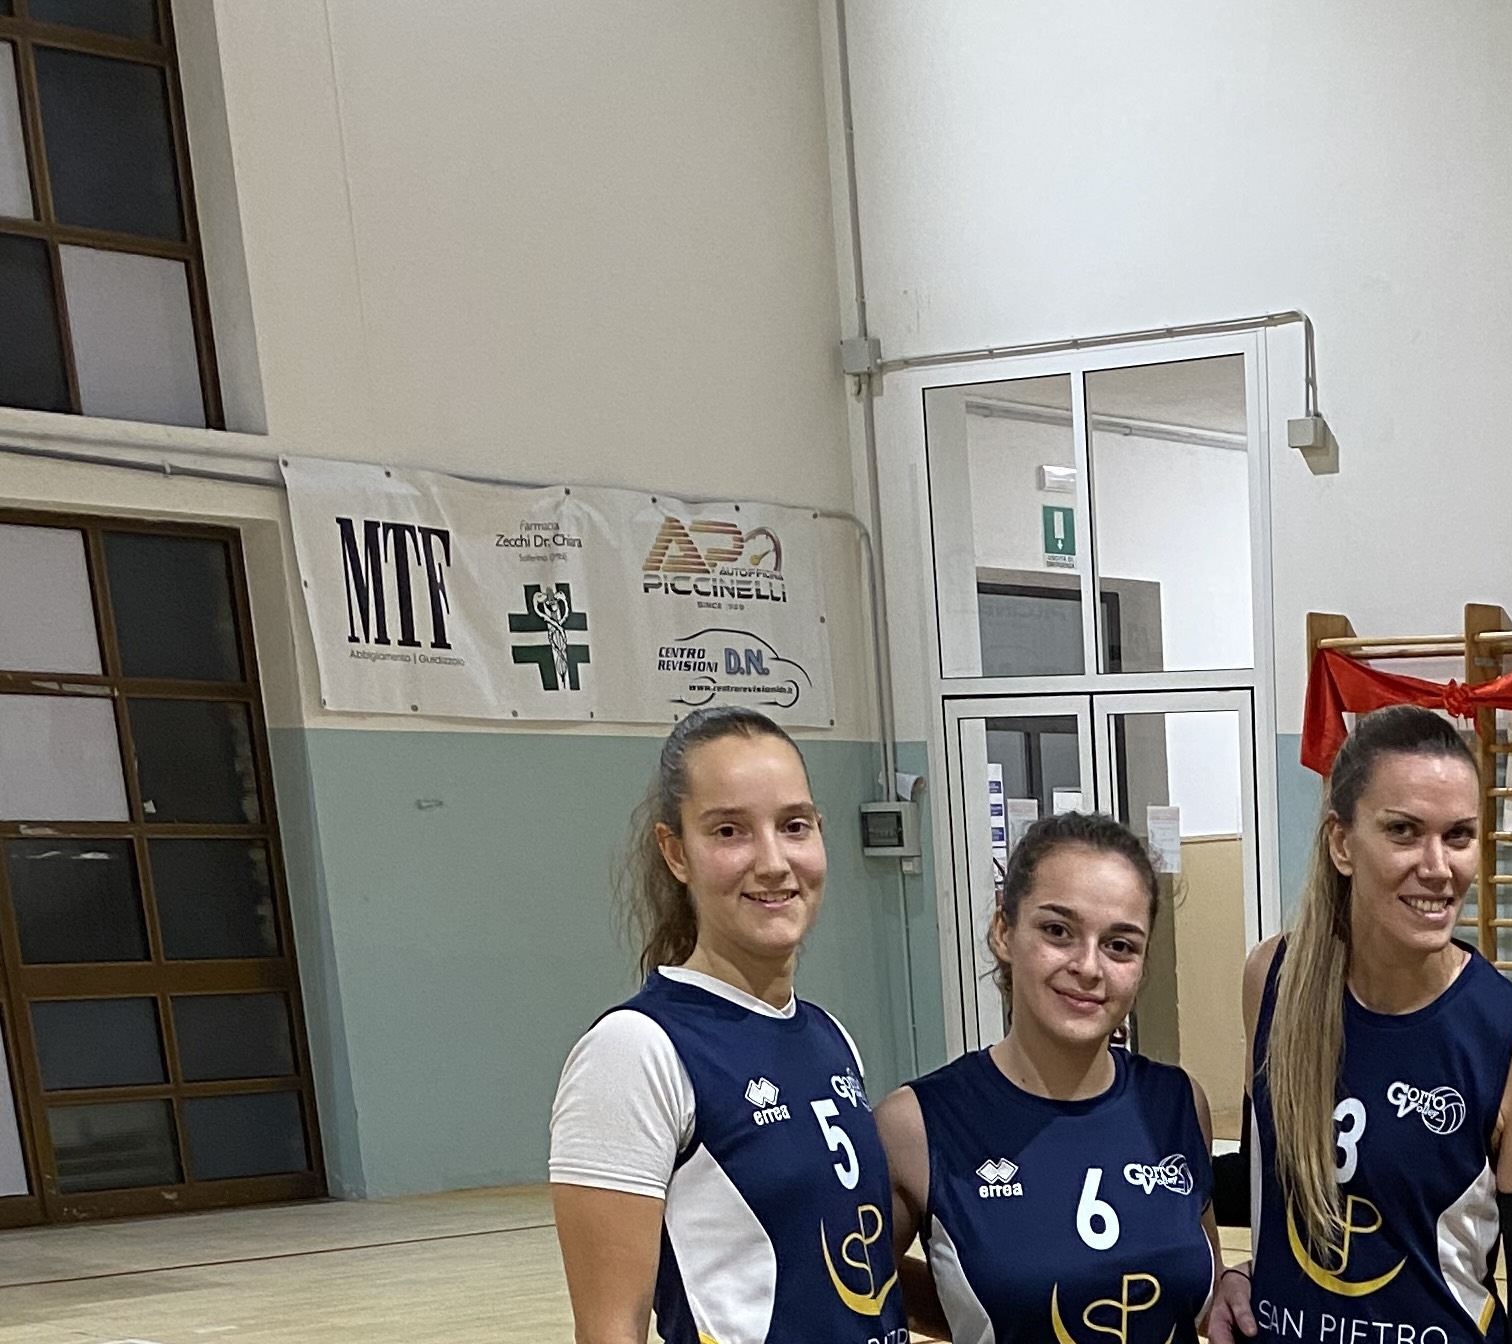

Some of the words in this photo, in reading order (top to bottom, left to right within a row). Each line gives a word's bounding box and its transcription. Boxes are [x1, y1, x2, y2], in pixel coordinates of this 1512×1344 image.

[495, 534, 530, 548] Zecchi
[335, 516, 452, 650] MTF
[643, 573, 787, 602] PICCINELLI
[657, 659, 719, 673] REVISIONI
[658, 646, 706, 660] CENTRO
[724, 647, 771, 676] D.N.
[753, 1104, 791, 1126] errea
[810, 1099, 860, 1190] 5
[979, 1183, 1023, 1198] errea
[1076, 1168, 1120, 1250] 6
[1258, 1299, 1304, 1339] SAN
